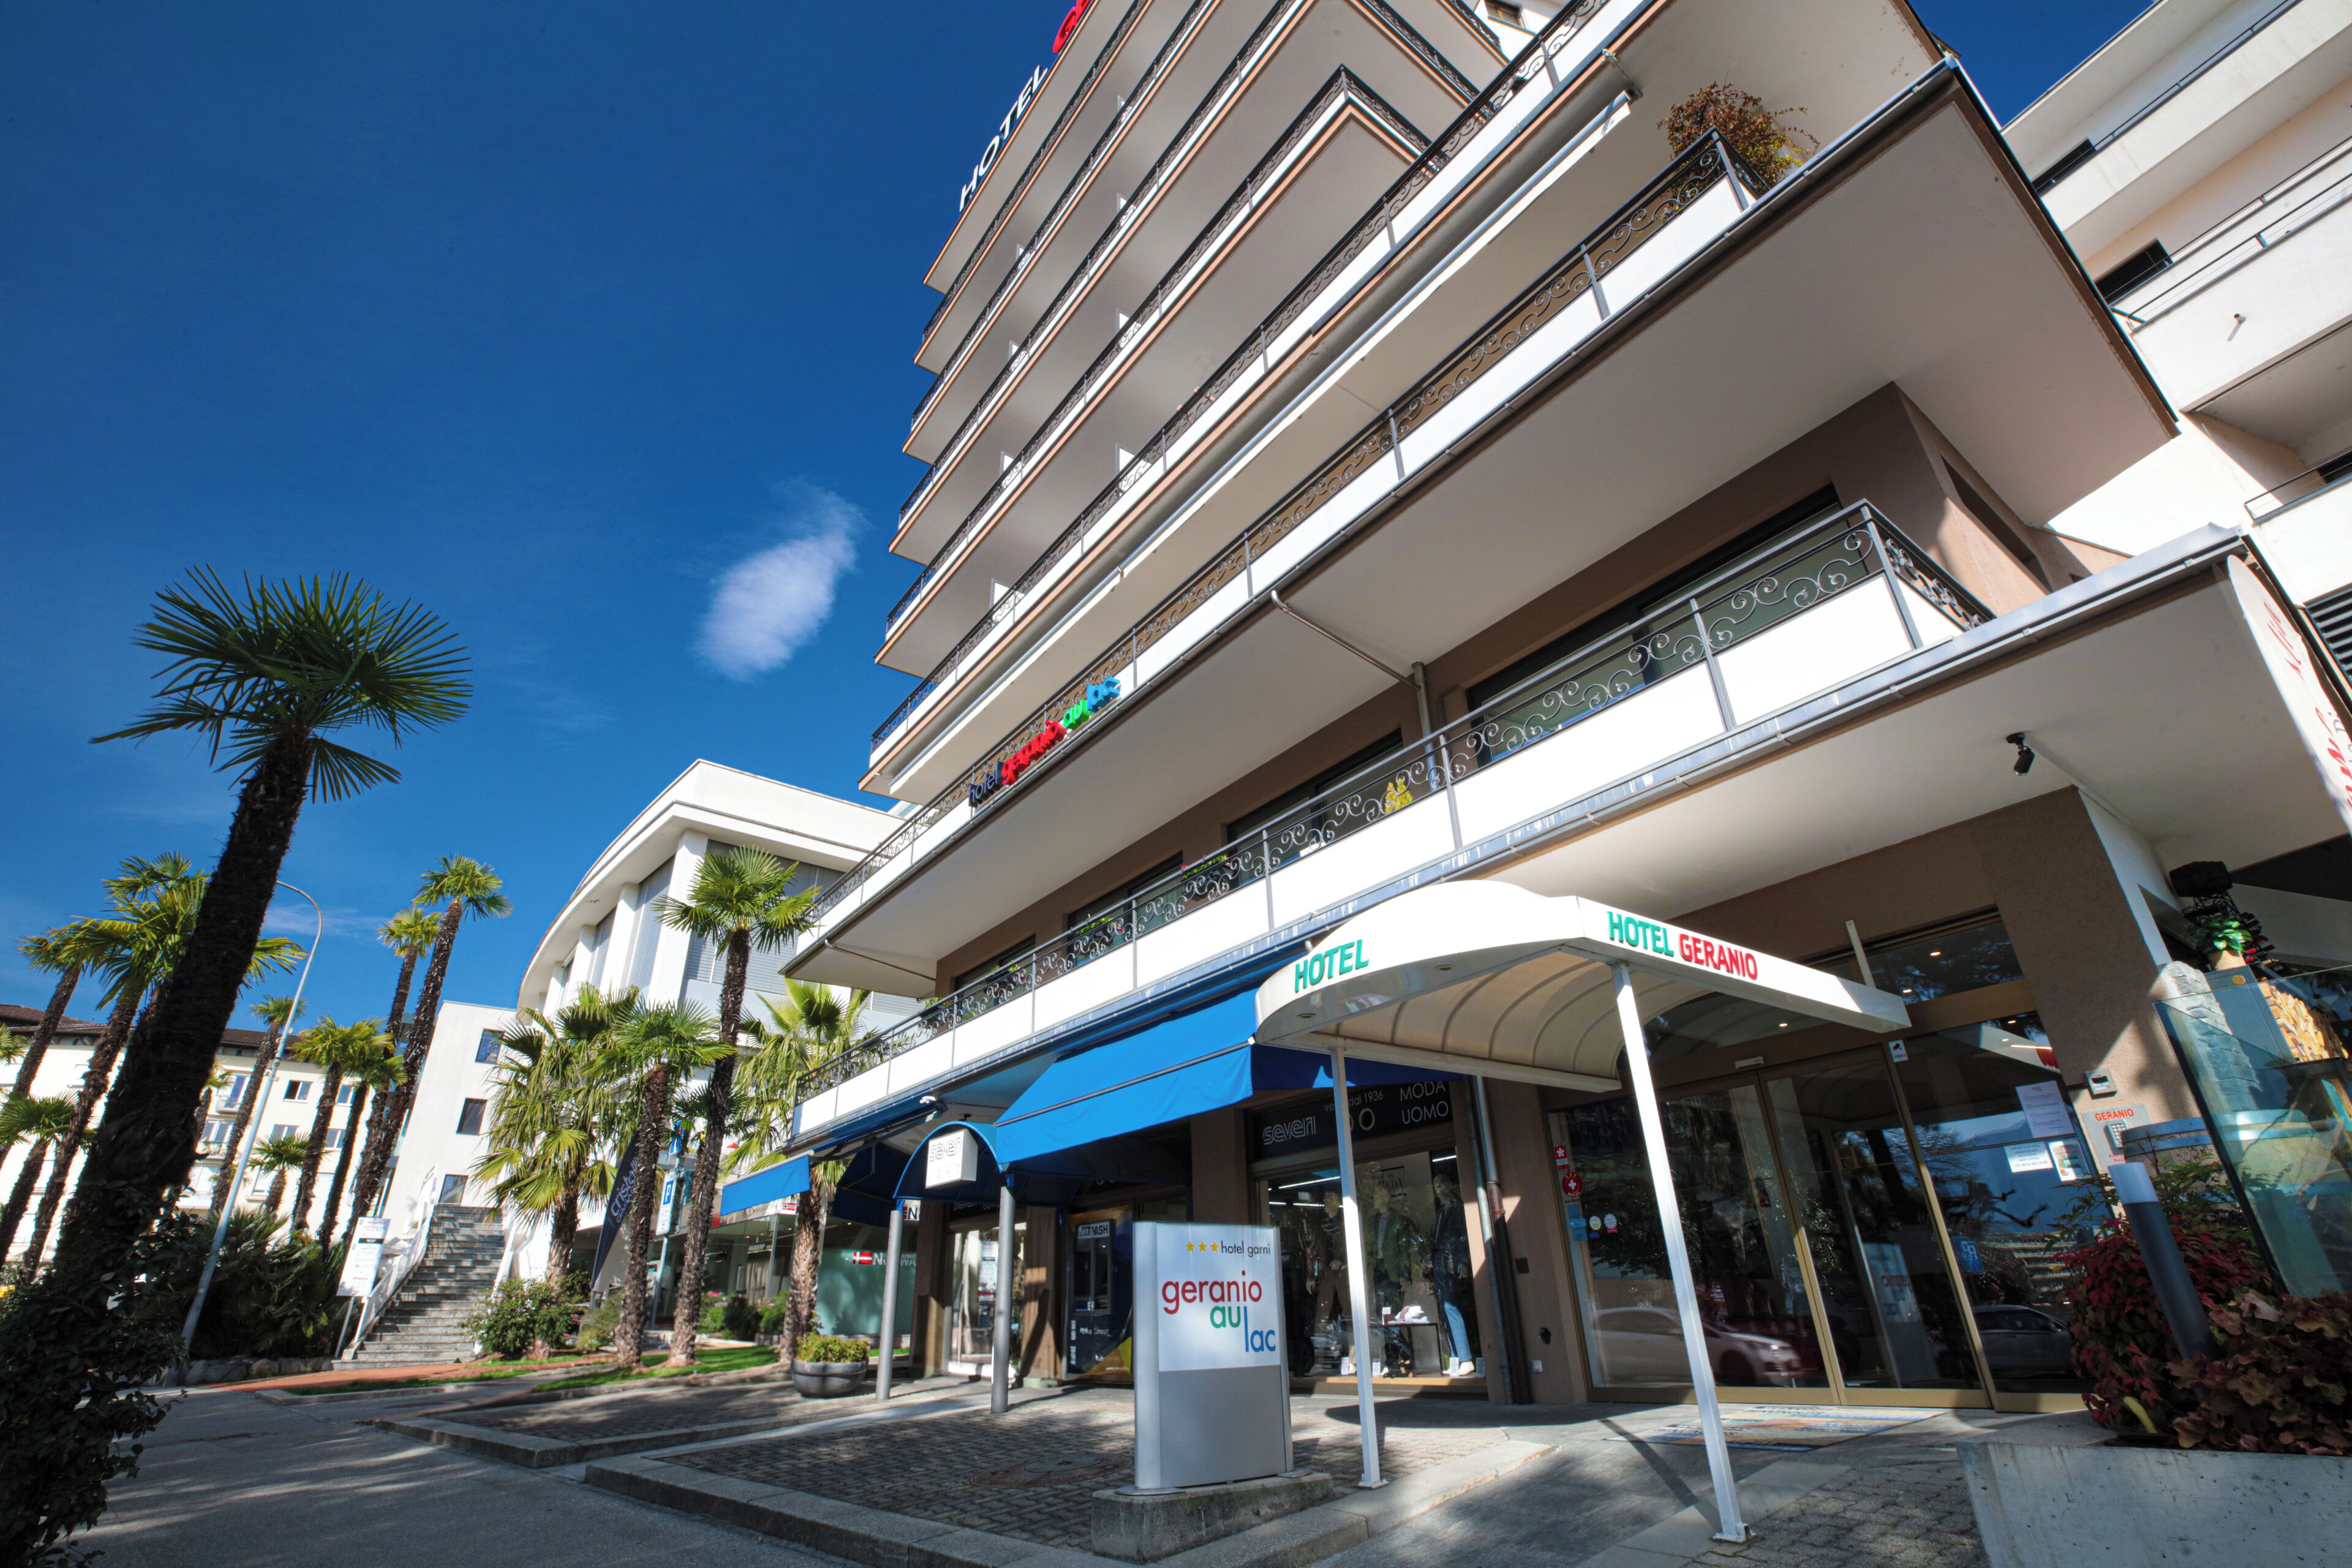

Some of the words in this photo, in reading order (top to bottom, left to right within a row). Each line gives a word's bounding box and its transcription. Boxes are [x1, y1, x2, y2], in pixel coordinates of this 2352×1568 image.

[959, 65, 1048, 213] HOTEL
[968, 761, 1002, 806] hotel
[1001, 720, 1066, 785] geranio
[1063, 699, 1091, 729] au
[1086, 676, 1120, 712] lac
[1607, 911, 1674, 957] HOTEL
[1679, 933, 1758, 980] GERANIO
[1295, 939, 1370, 993] HOTEL
[1349, 1094, 1362, 1107] dal
[1364, 1090, 1384, 1103] 1936
[1400, 1080, 1446, 1102] MODA
[1401, 1101, 1449, 1125] UOMO
[2094, 1108, 2135, 1121] GERANIO
[1263, 1116, 1316, 1145] seven
[930, 1137, 962, 1162] seven
[665, 1184, 672, 1202] P
[1221, 1240, 1244, 1254] hotel
[1247, 1243, 1270, 1257] garni
[1162, 1270, 1262, 1314] geranio
[1210, 1305, 1241, 1329] au
[1243, 1306, 1276, 1352] lac
